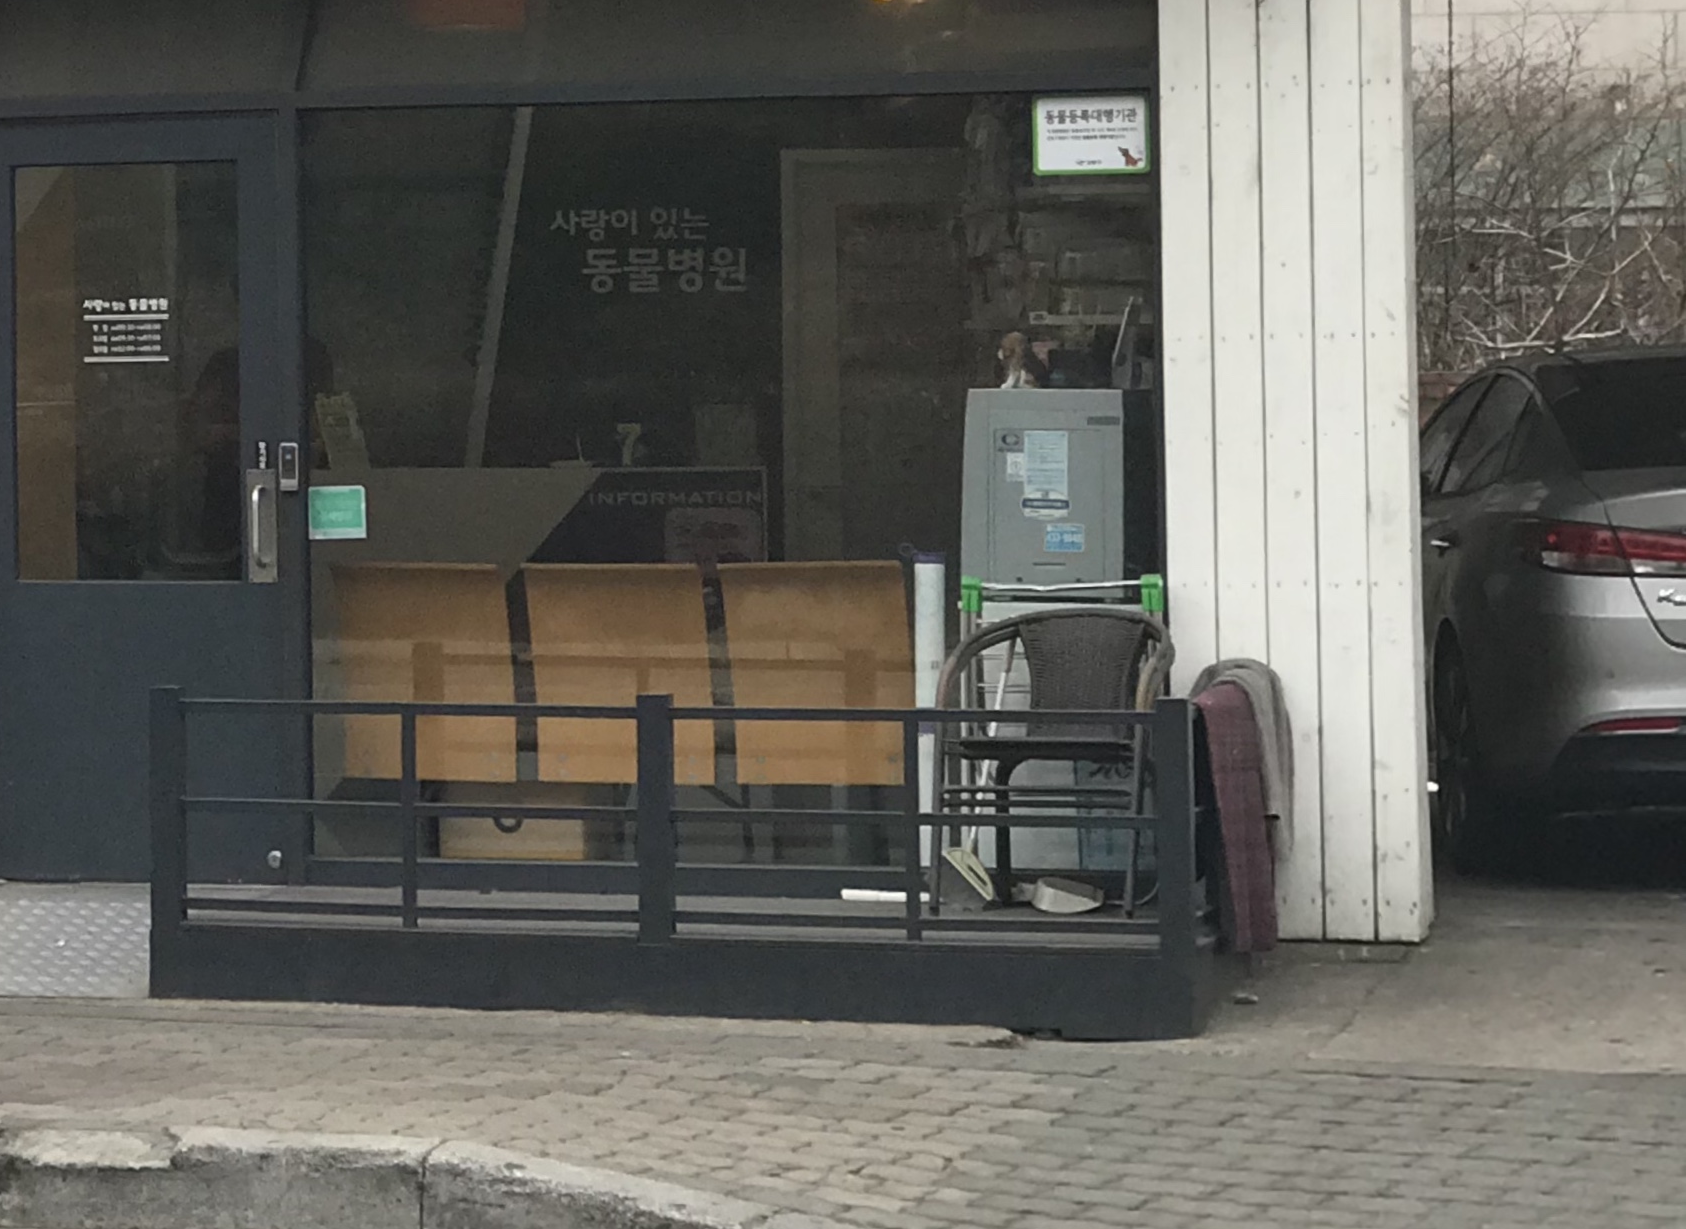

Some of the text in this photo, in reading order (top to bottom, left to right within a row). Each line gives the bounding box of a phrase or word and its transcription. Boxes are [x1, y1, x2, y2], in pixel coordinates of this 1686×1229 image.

[549, 206, 710, 242] 사랑이 있는
[581, 247, 747, 293] 동물병원
[589, 490, 762, 507] INFORMATION
